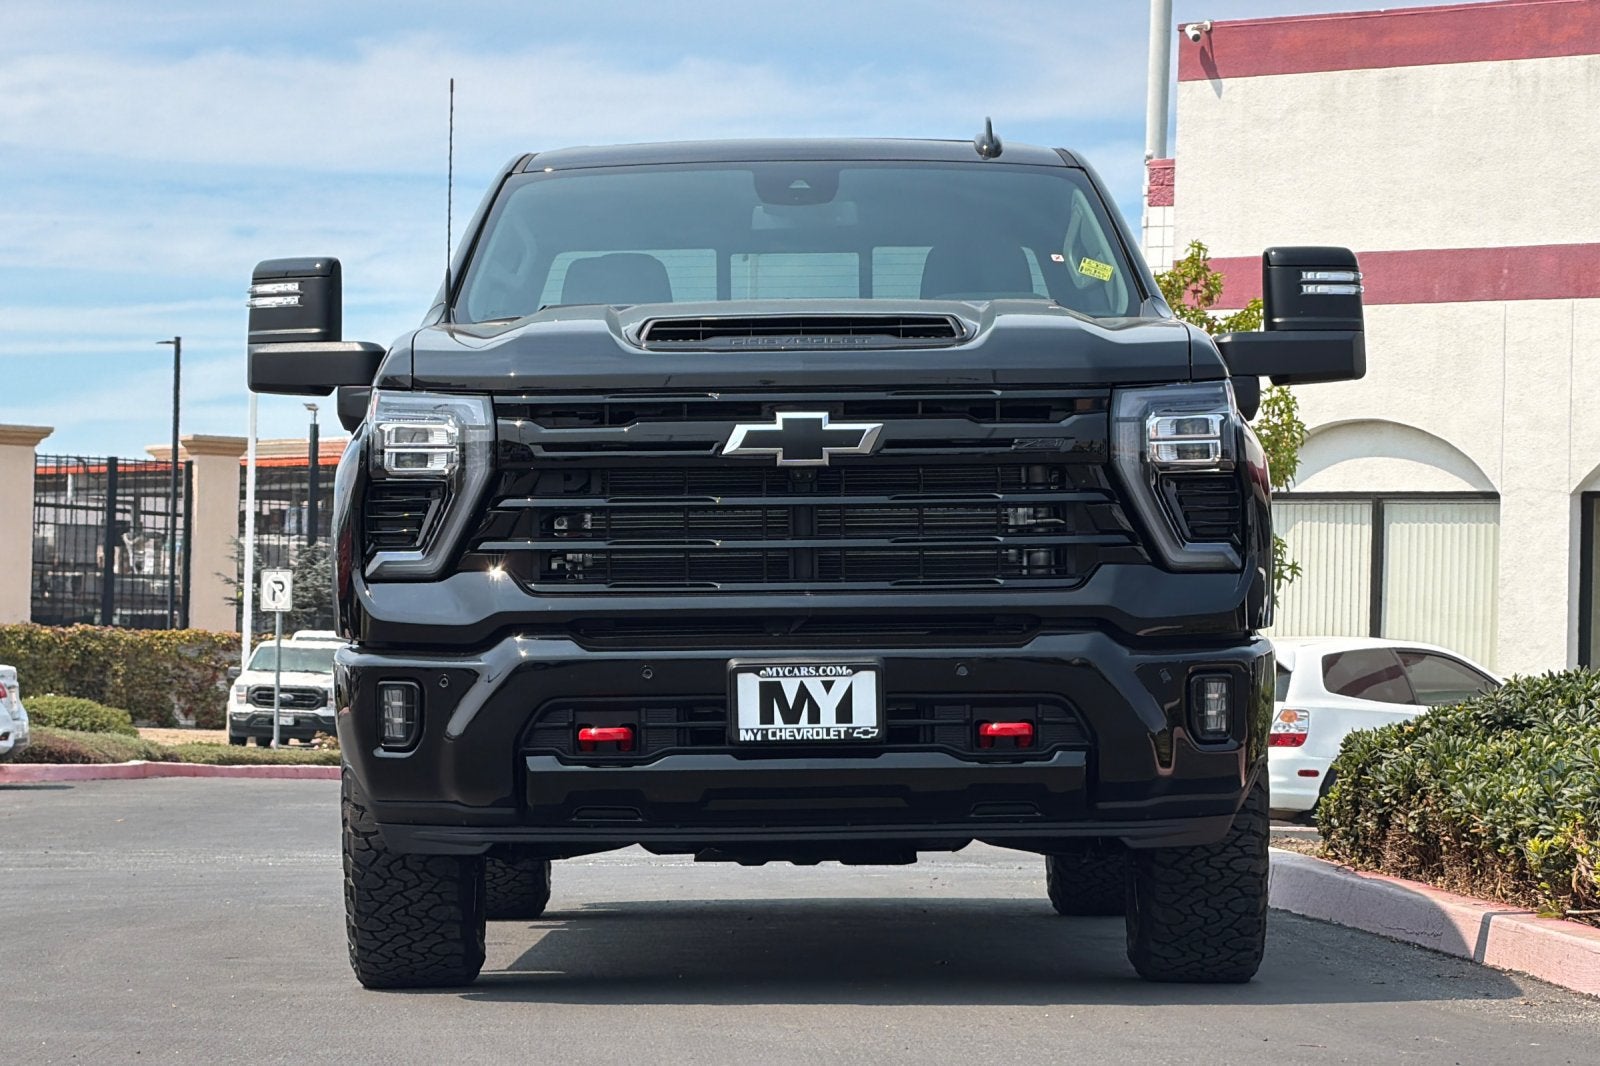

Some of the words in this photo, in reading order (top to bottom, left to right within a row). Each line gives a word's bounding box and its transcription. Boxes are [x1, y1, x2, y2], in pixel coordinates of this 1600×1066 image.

[765, 666, 847, 677] MYCARS.COM
[739, 729, 762, 741] MY
[767, 727, 847, 740] CHEVROLET
